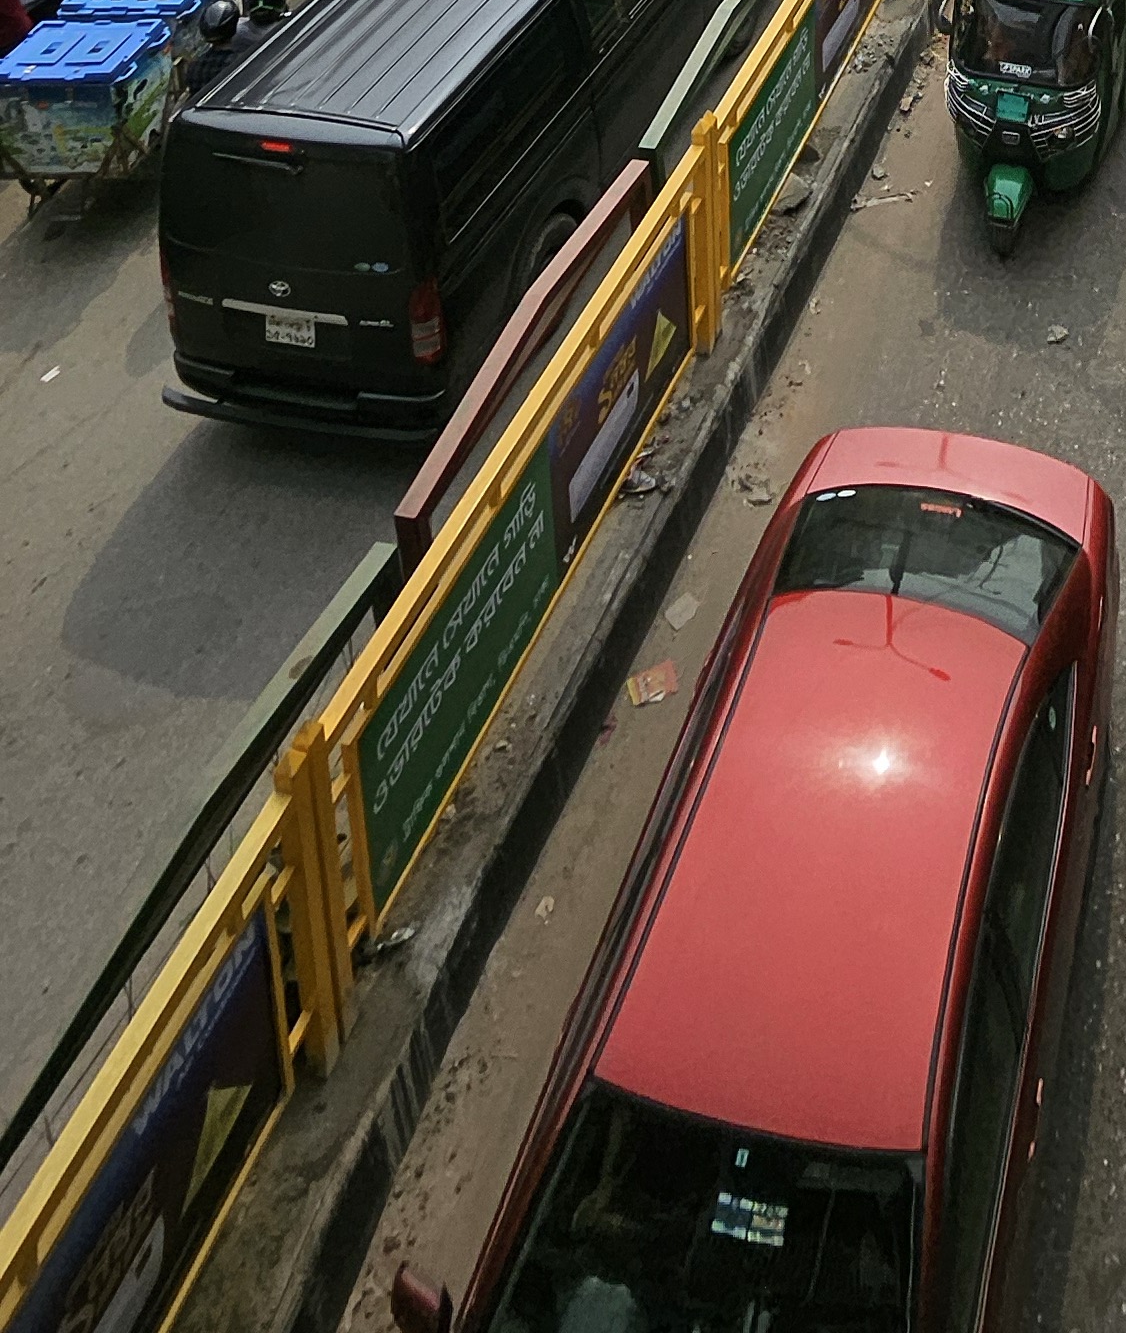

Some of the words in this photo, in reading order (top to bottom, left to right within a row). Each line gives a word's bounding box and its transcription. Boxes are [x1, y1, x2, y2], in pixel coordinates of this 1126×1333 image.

[374, 653, 463, 815] ওভারটেক
[464, 548, 529, 652] করবেন
[376, 651, 441, 761] যেখানে
[443, 542, 502, 651] সেখানে
